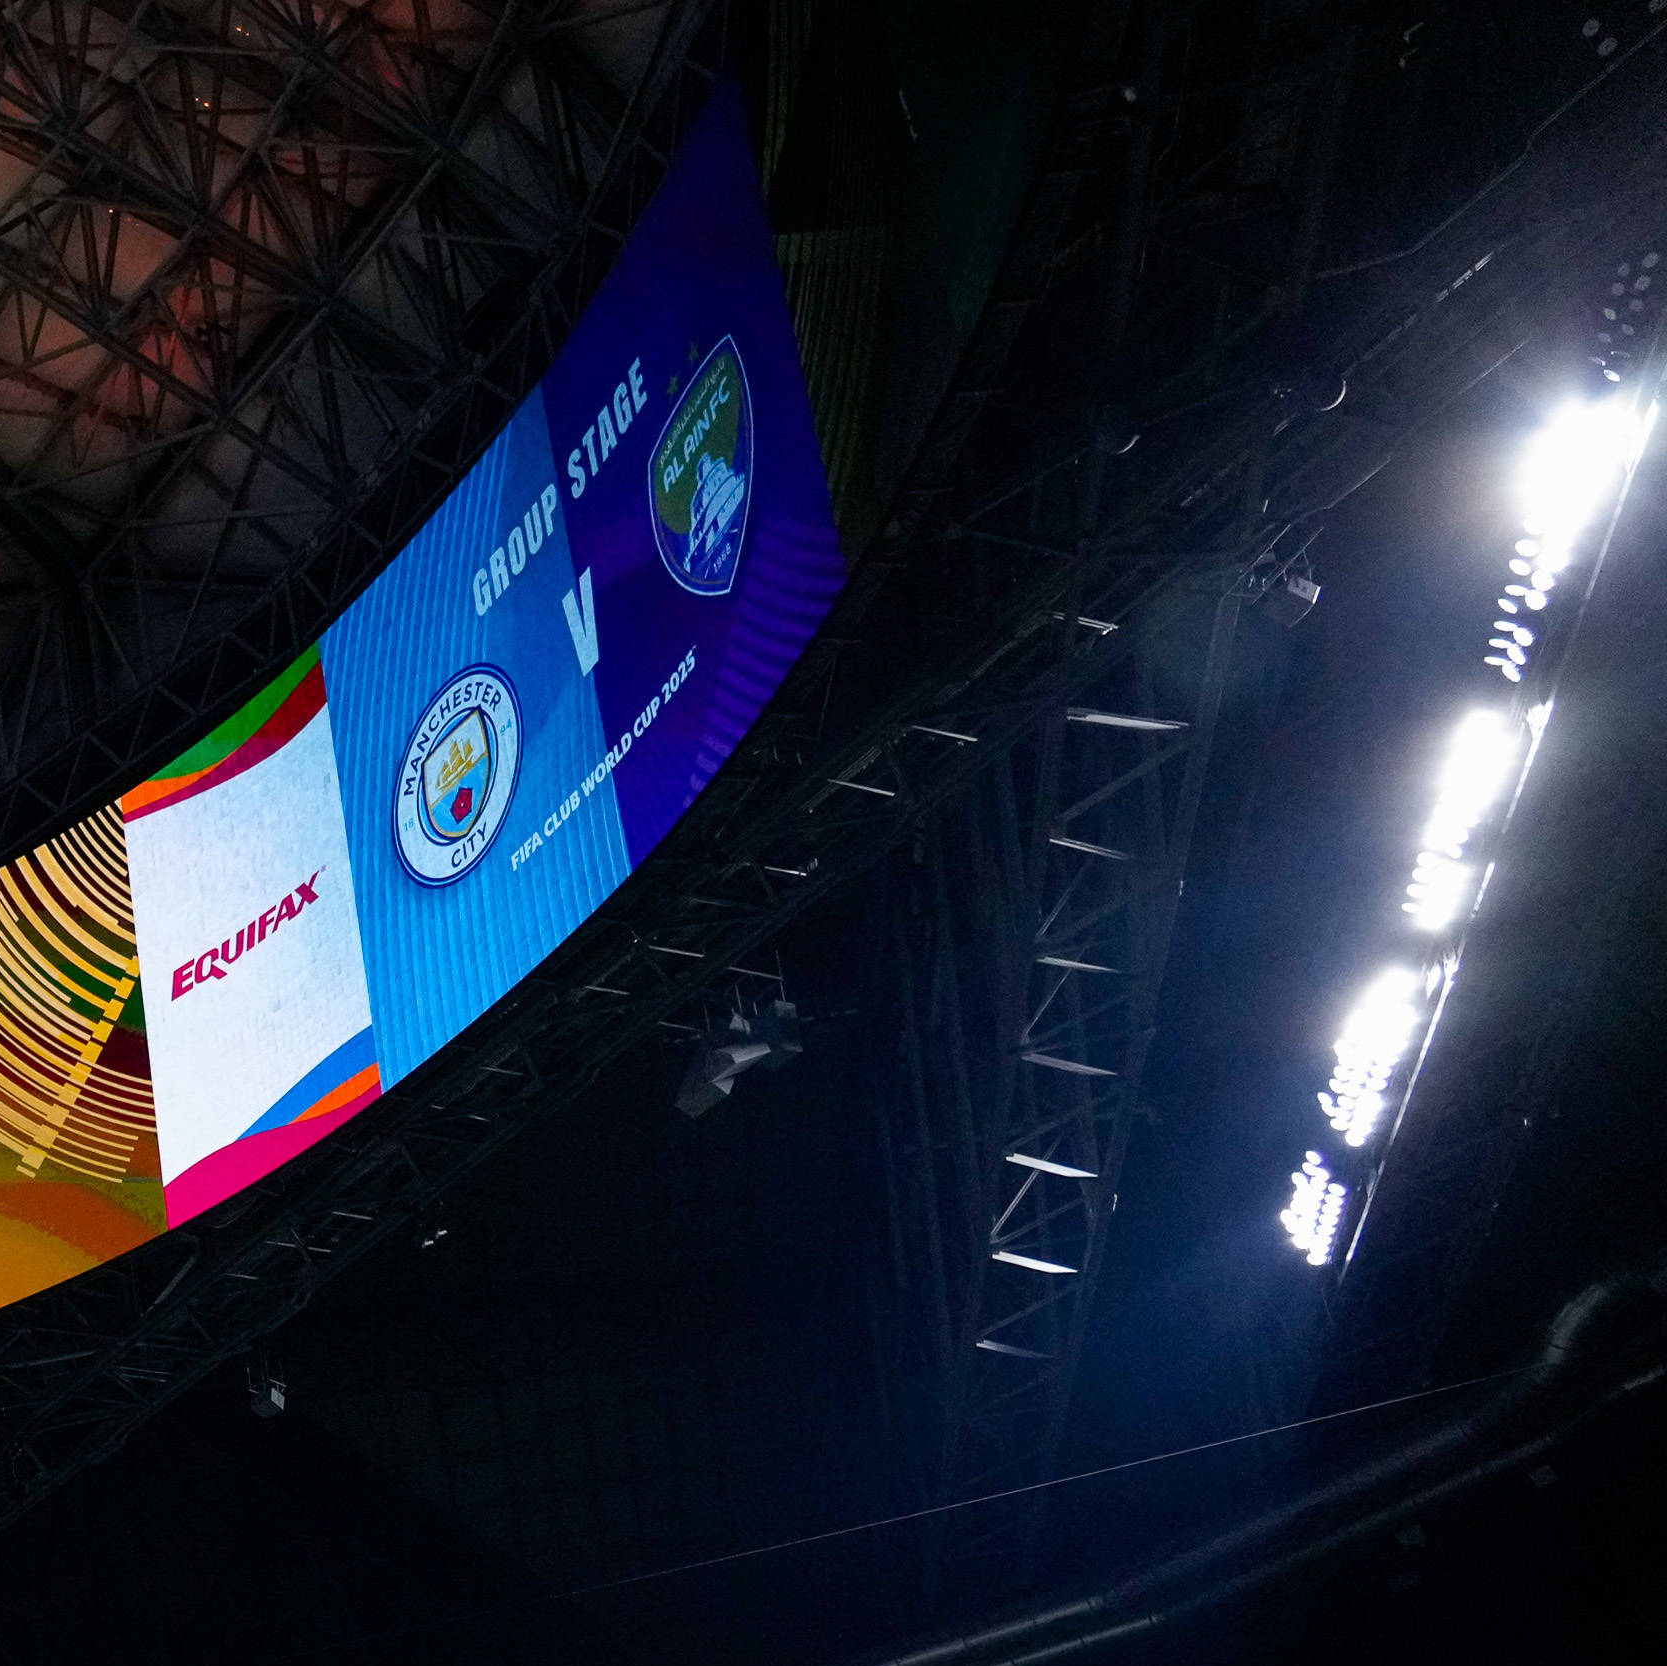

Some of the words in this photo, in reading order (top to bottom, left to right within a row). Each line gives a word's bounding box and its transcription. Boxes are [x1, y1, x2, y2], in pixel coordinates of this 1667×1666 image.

[472, 482, 558, 617] GROUP
[567, 356, 648, 500] STAGE
[663, 456, 684, 493] AL
[684, 408, 711, 462] AIN
[561, 566, 601, 676] V
[403, 681, 501, 797] MANCHESTER
[510, 831, 543, 873] FIFA
[543, 789, 581, 841] CLUB
[581, 730, 632, 799] WORLD
[633, 701, 661, 738] CUP
[451, 822, 488, 869] CITY
[170, 869, 321, 1001] EQUIFAX
